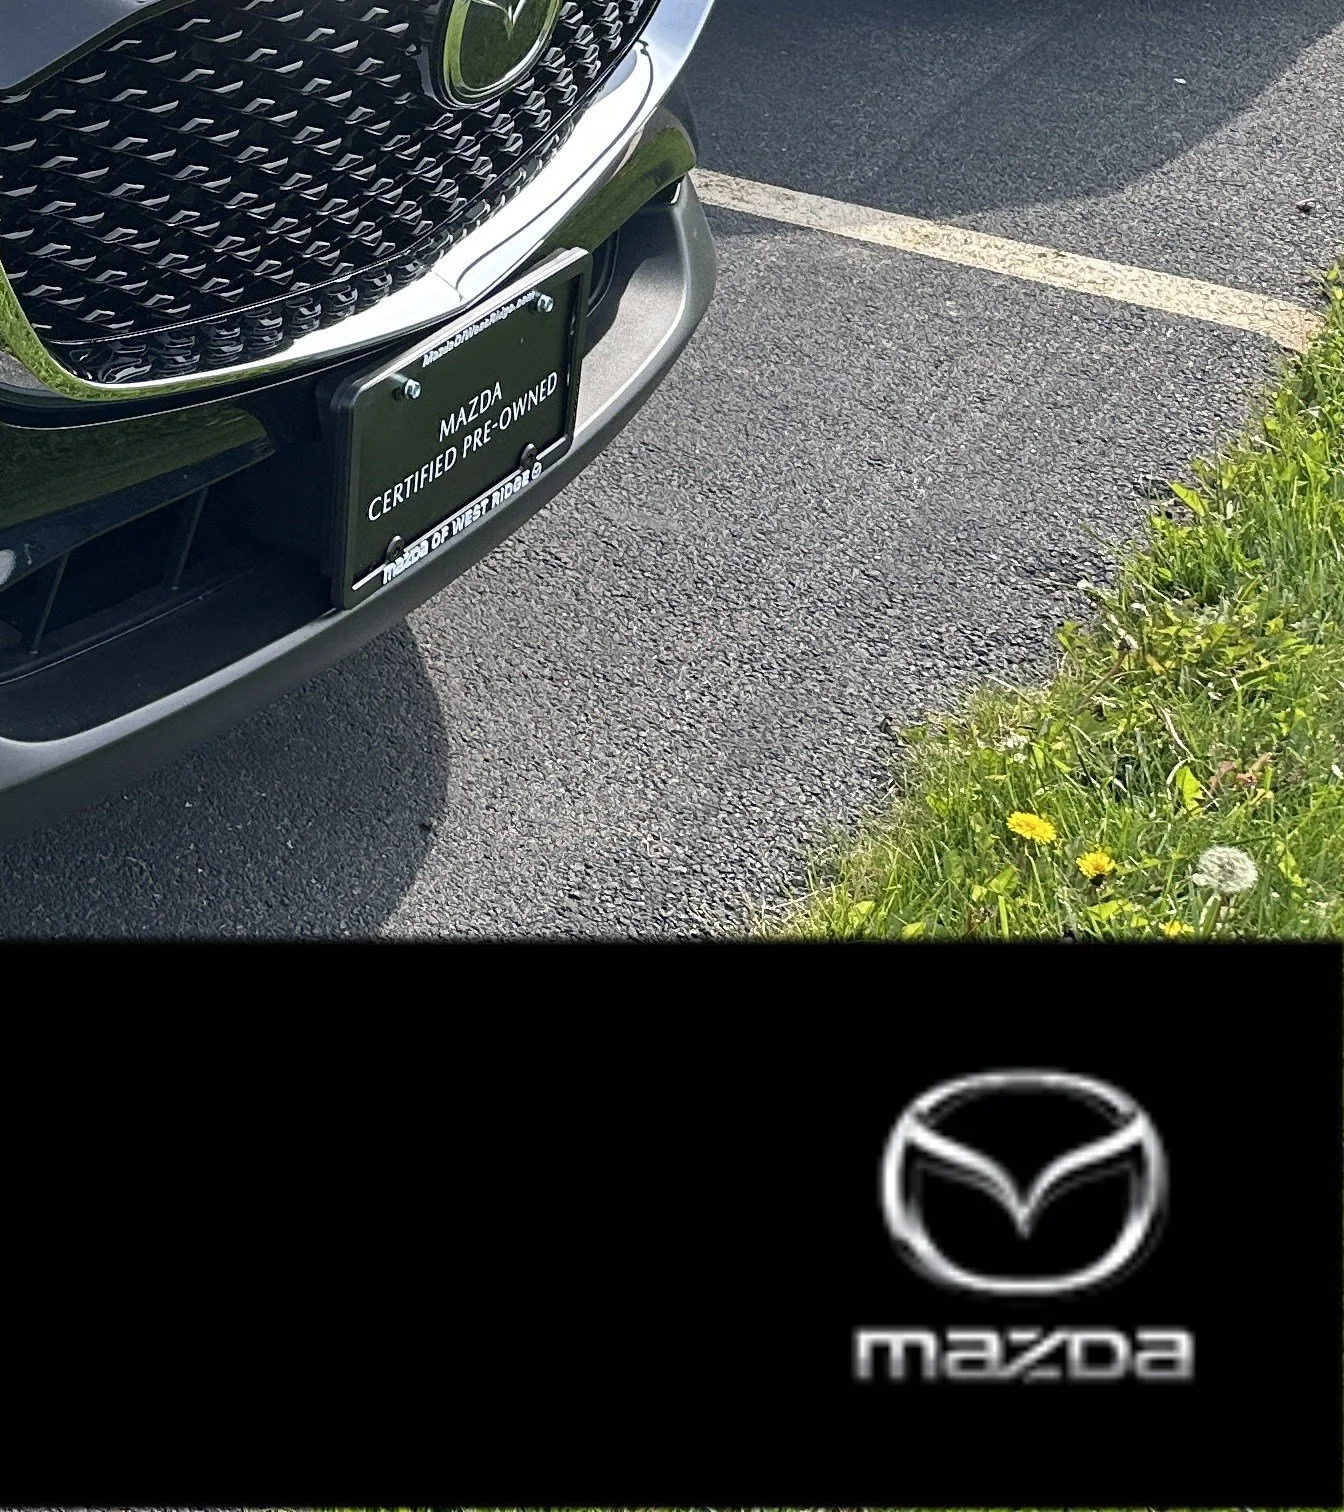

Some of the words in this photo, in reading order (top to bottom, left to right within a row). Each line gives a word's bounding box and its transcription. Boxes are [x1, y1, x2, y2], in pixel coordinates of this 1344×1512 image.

[367, 445, 459, 522] CERTIFIED
[461, 370, 559, 459] PRE-OWNED
[438, 380, 503, 443] MAZDA
[431, 524, 450, 551] OF
[451, 497, 490, 536] WEST
[490, 468, 531, 510] RIDGE
